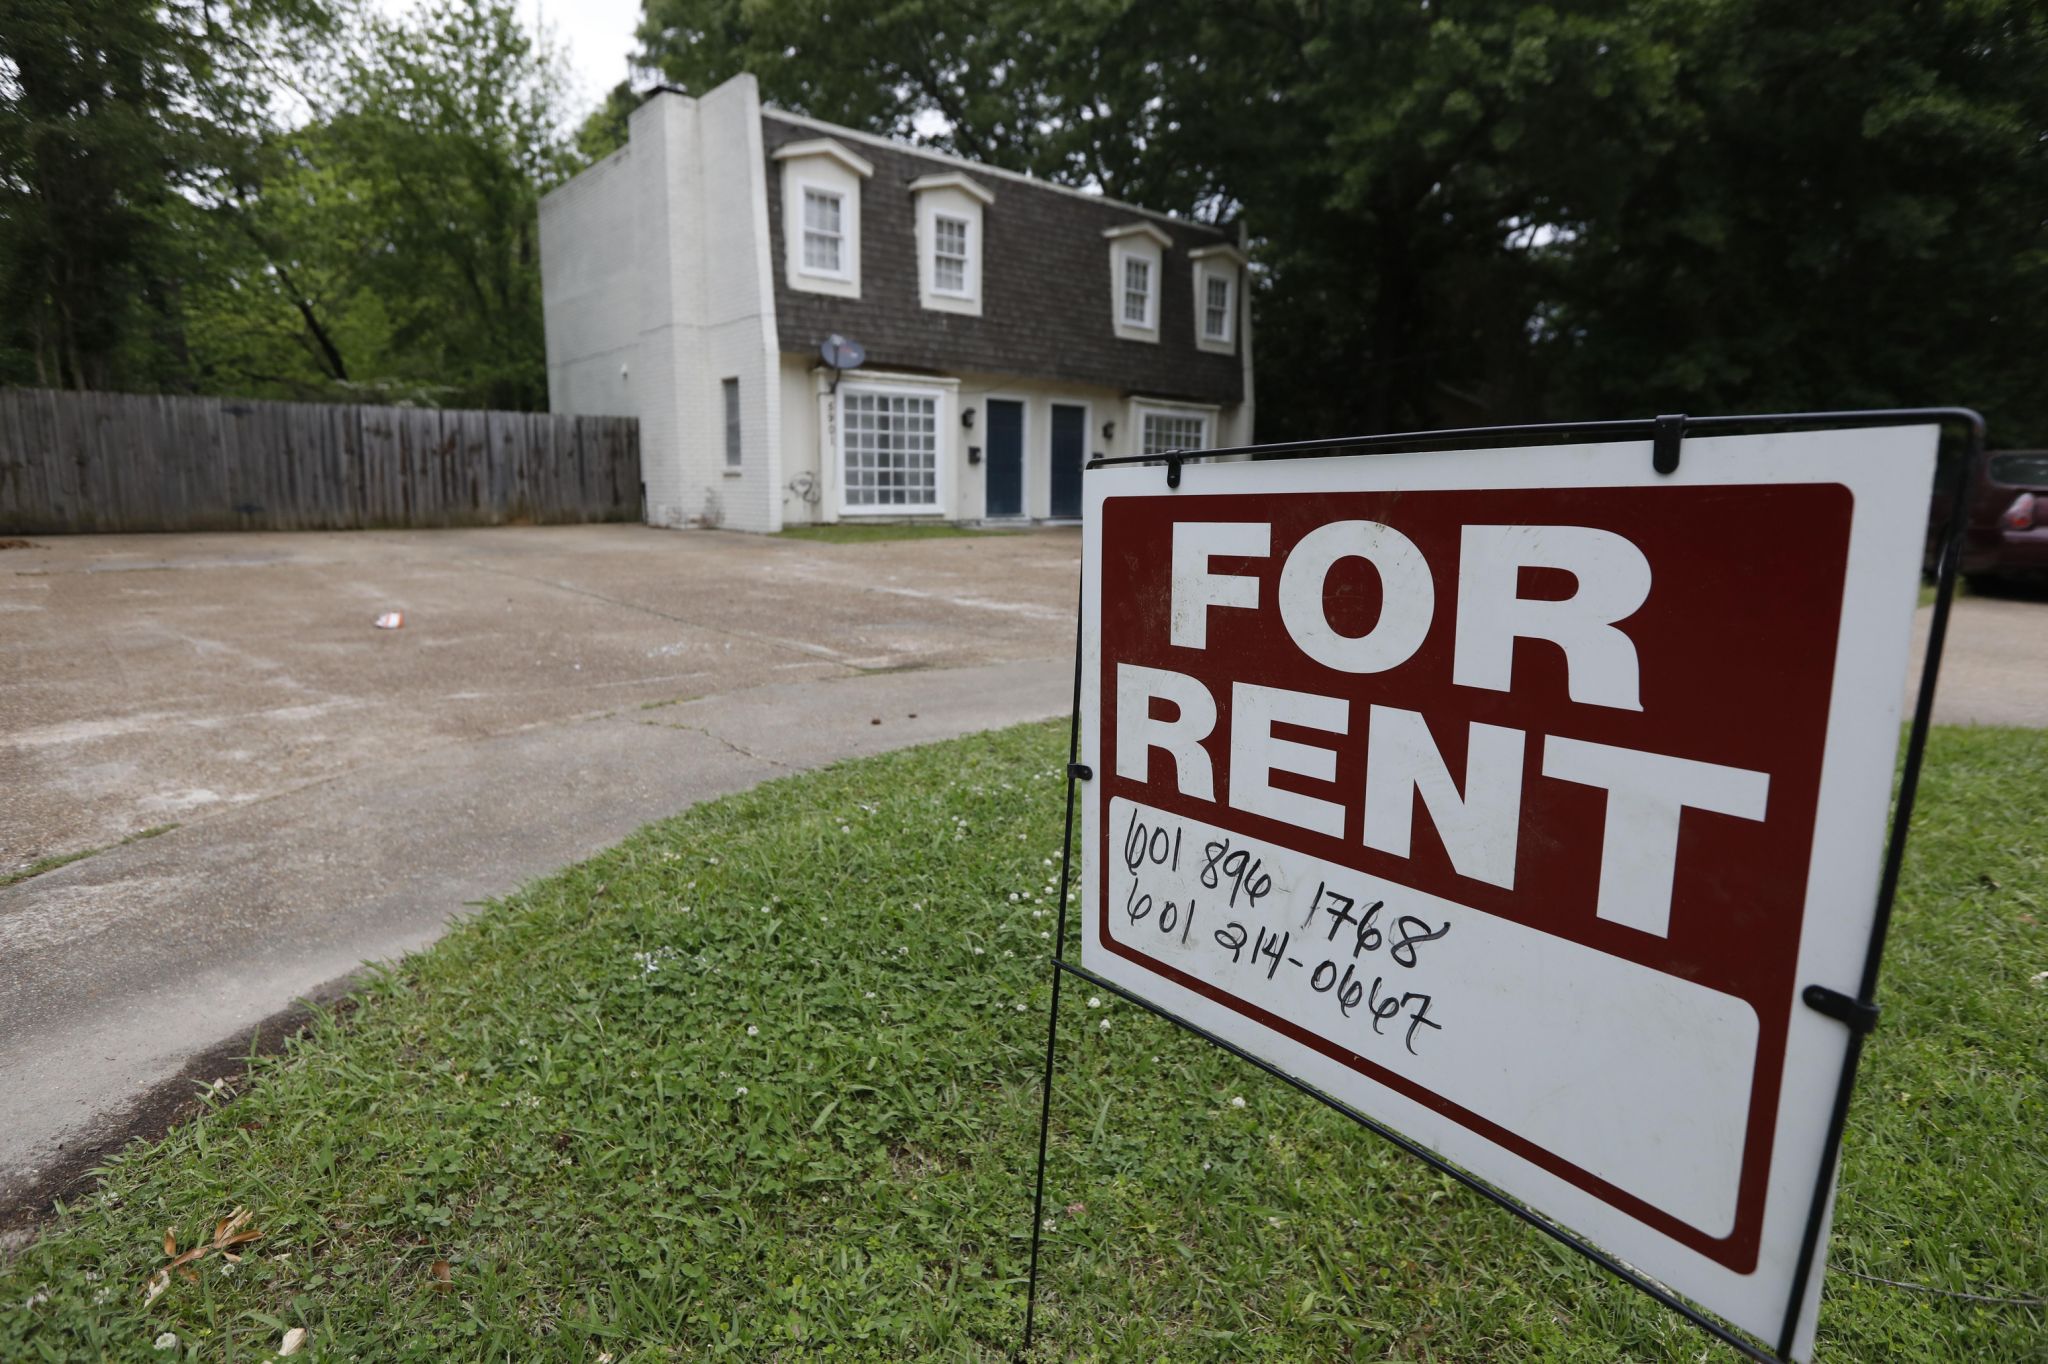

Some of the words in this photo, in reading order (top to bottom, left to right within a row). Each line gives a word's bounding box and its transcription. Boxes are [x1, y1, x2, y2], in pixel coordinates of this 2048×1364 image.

[1170, 520, 1652, 712] FOR
[1116, 662, 1770, 938] RENT
[1124, 808, 1182, 876] 601
[1200, 838, 1272, 908] 896
[1301, 881, 1451, 968] 1768
[1126, 877, 1196, 944] 601
[1215, 922, 1443, 1056] 214-0667
